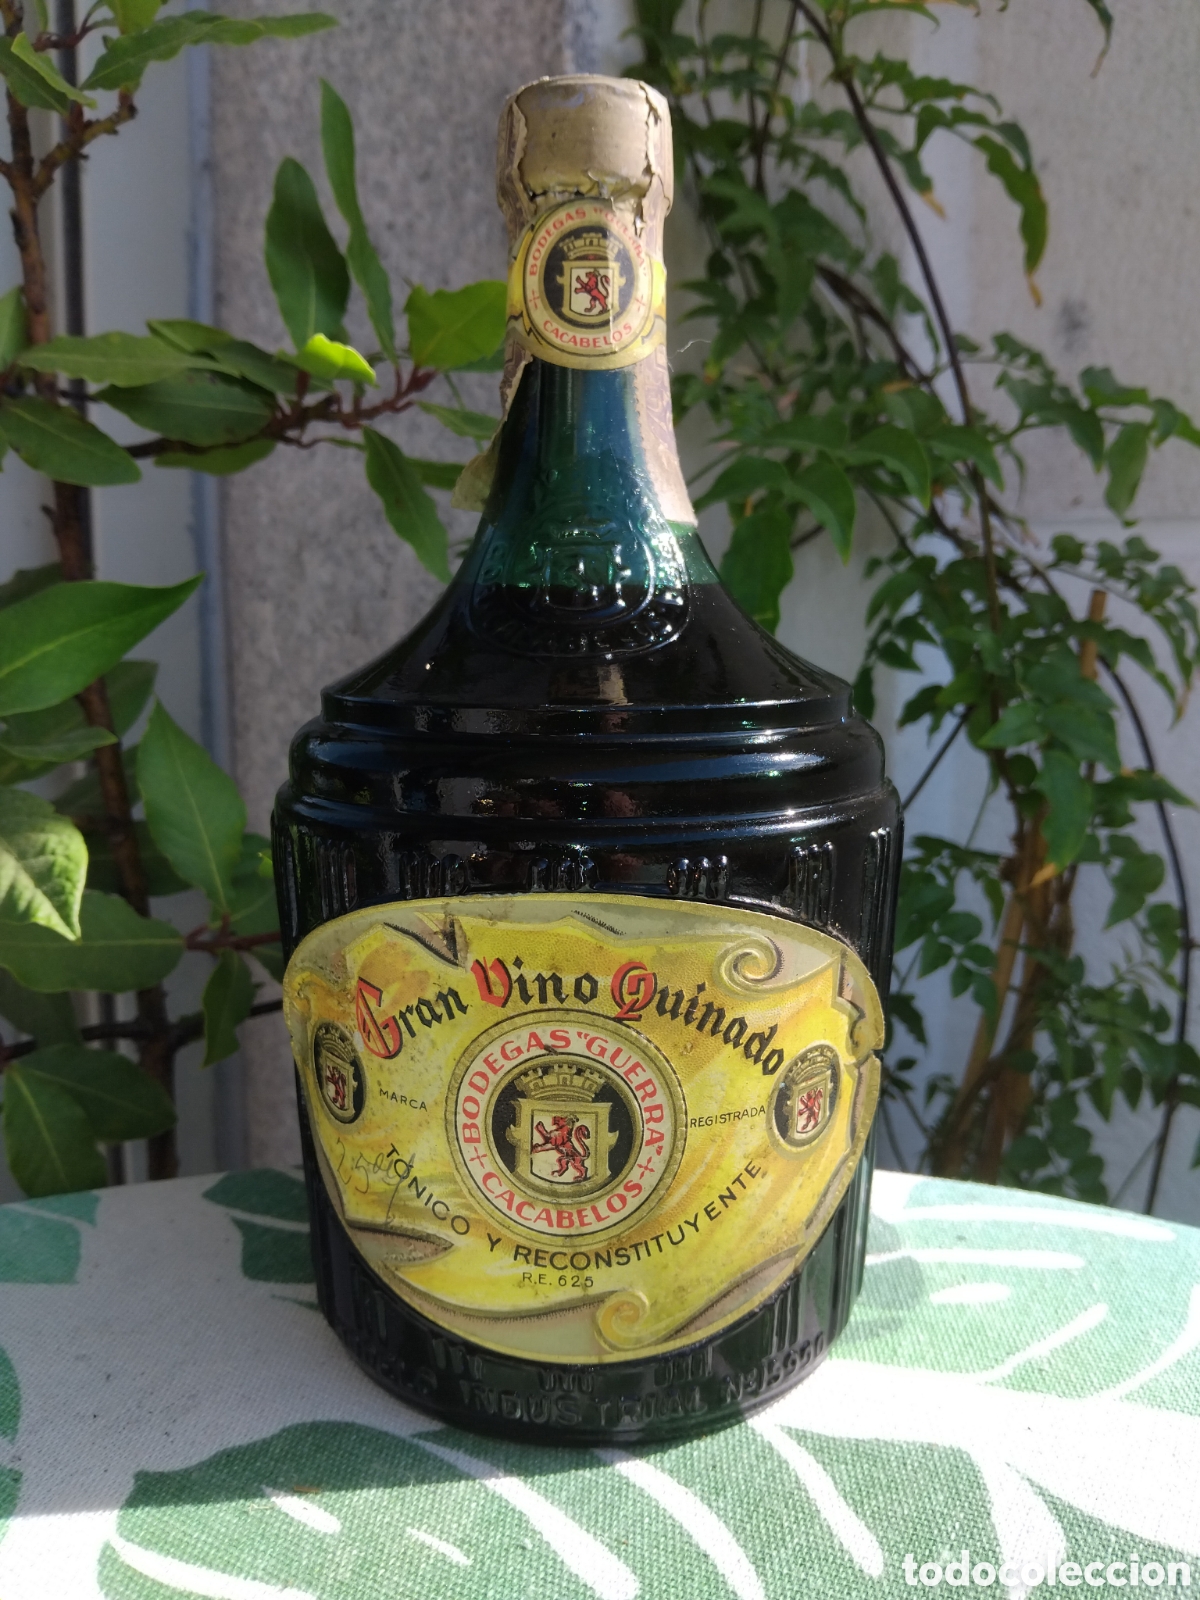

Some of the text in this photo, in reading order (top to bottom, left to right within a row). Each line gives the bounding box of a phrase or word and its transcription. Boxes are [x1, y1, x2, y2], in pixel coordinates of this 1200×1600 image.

[529, 208, 586, 276] BODEGAS
[543, 319, 632, 348] CACABELOS
[356, 955, 785, 1076] Gran Vino Quinado
[379, 1087, 428, 1112] MARCA
[461, 1029, 571, 1146] BODEGAS
[690, 1104, 766, 1129] REGISTRADA
[386, 1143, 470, 1235] TONICO
[486, 1233, 502, 1253] Y
[513, 1160, 762, 1271] RECONSTITUYENTE
[482, 1171, 643, 1229] CACABELOS
[522, 1272, 594, 1288] R.E. 625
